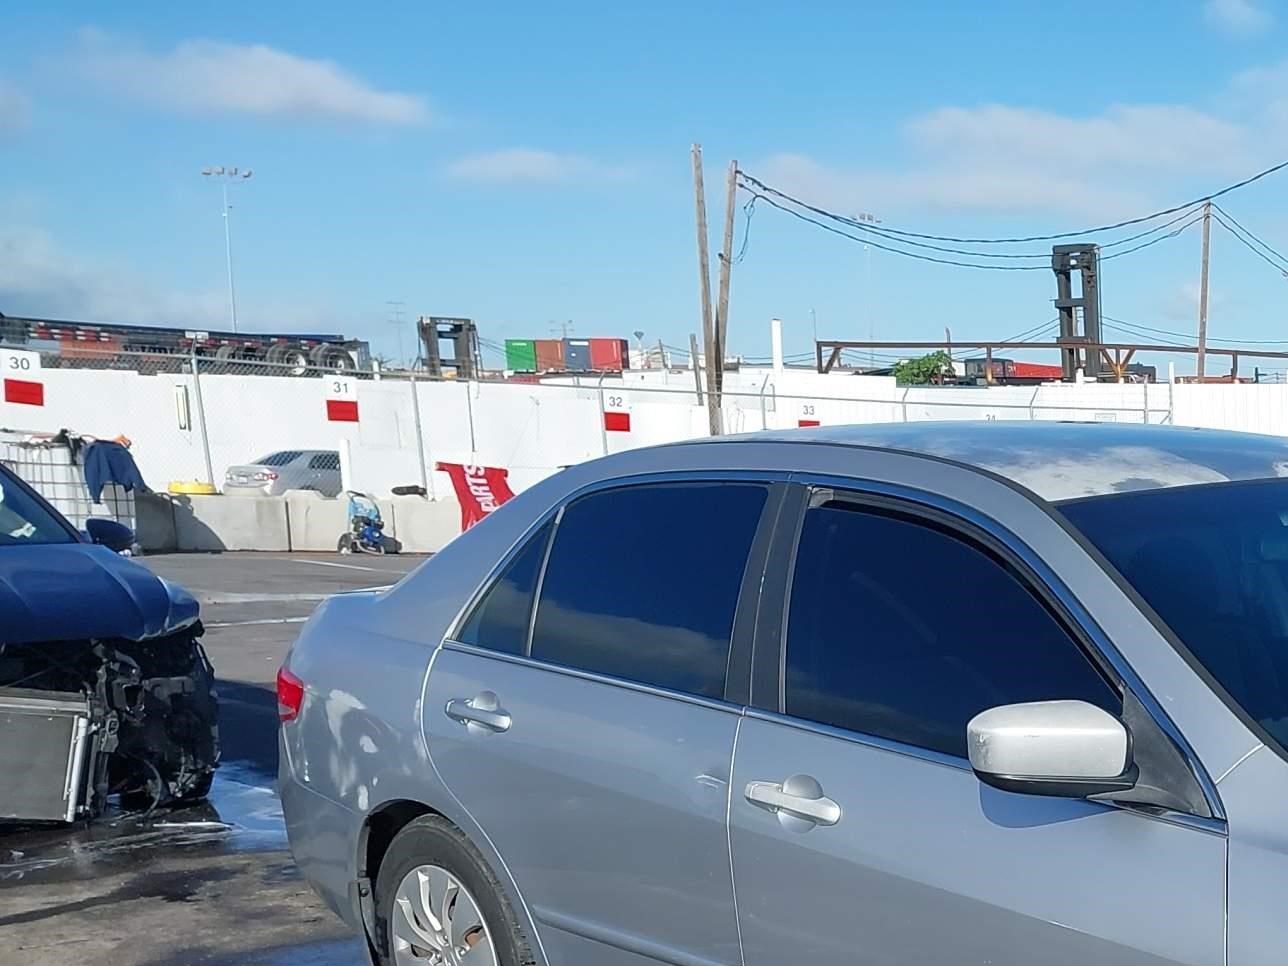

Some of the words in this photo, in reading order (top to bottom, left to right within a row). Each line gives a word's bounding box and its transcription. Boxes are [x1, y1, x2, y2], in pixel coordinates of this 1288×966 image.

[9, 356, 30, 370] 30
[333, 381, 348, 393] 31
[609, 396, 623, 407] 32
[803, 405, 815, 415] 33
